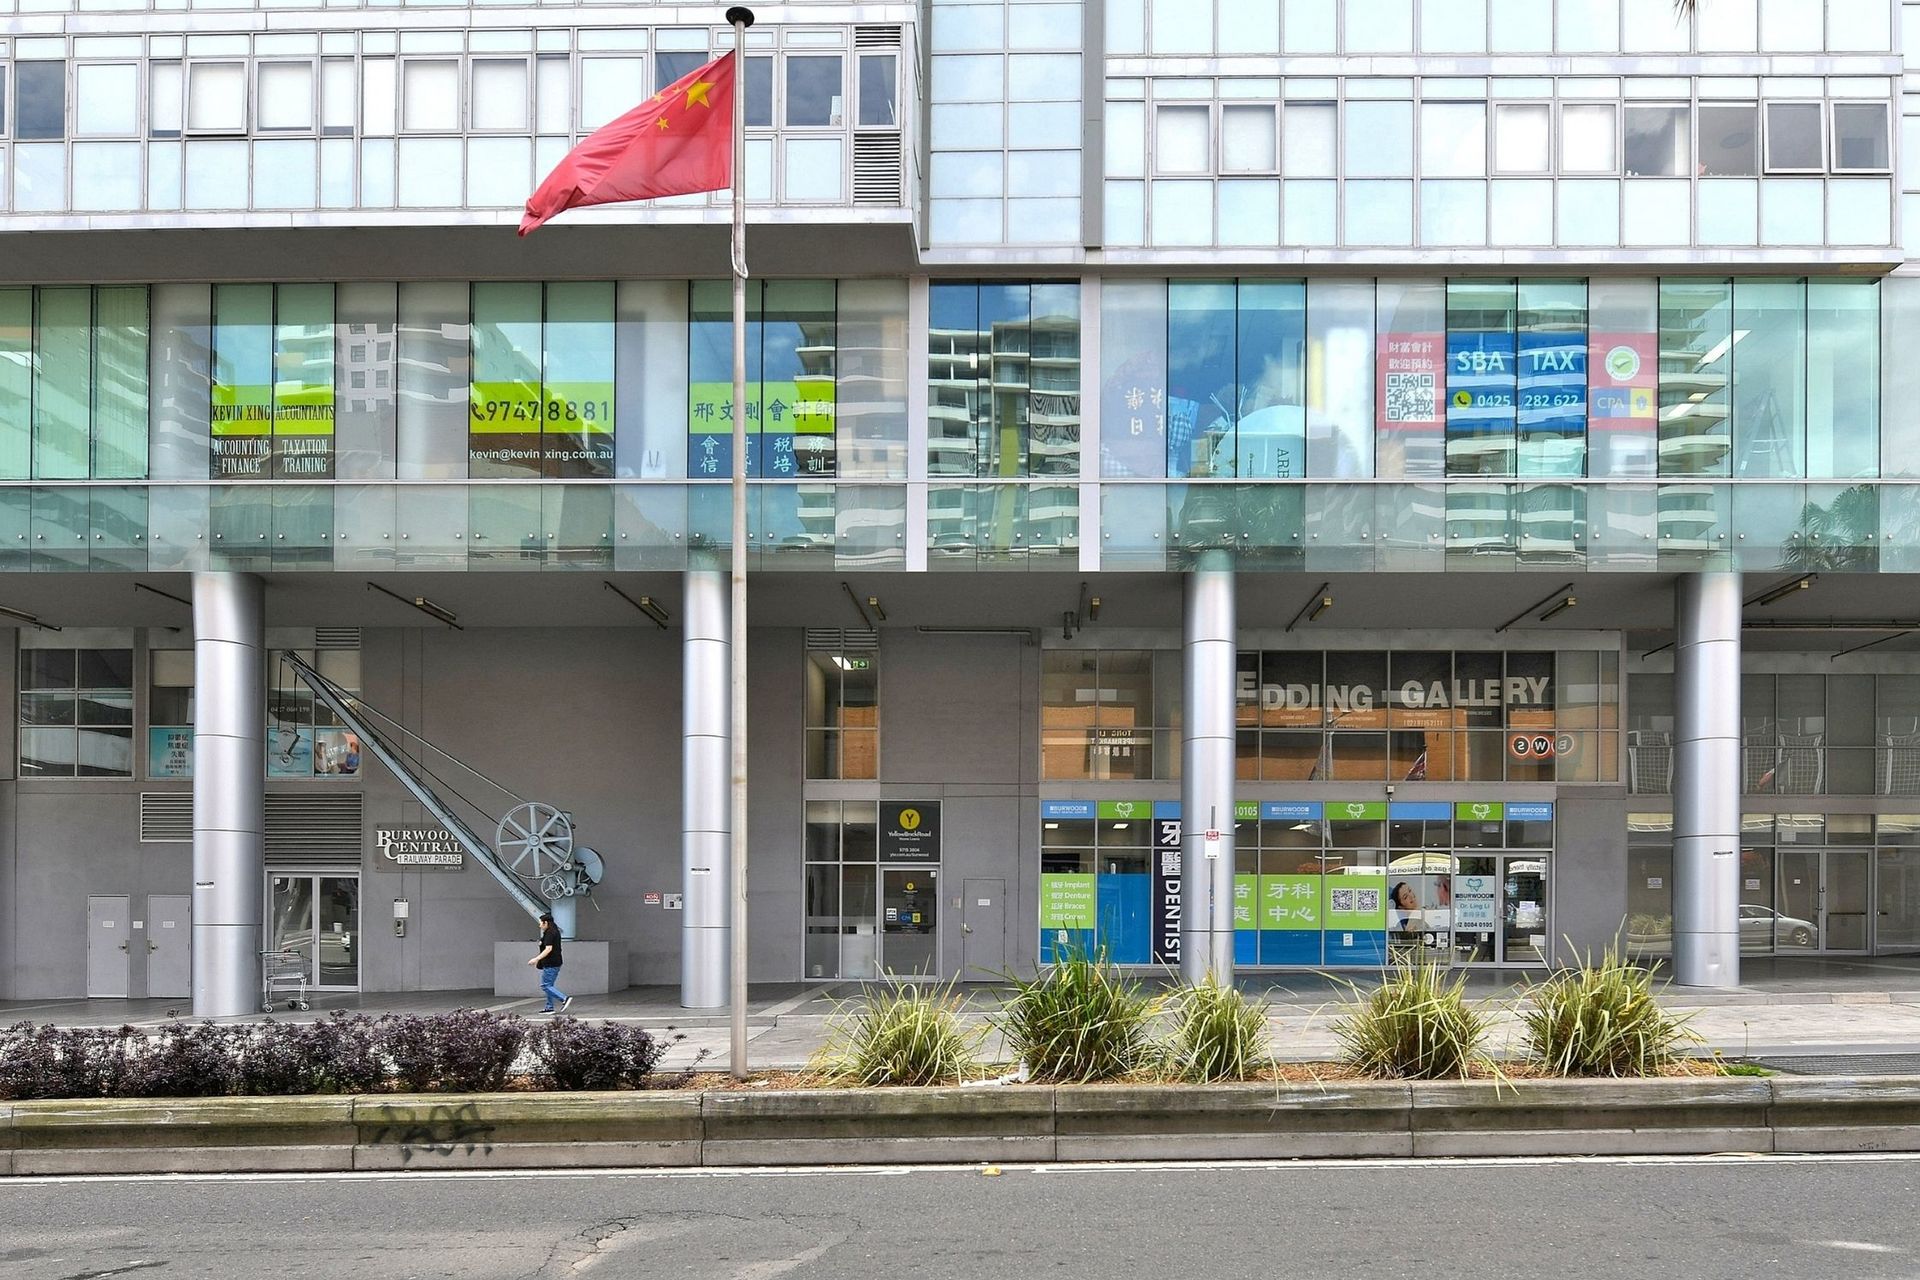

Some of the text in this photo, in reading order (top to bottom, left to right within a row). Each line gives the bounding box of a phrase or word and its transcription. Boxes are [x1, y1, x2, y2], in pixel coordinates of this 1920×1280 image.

[1457, 350, 1575, 371] SBA TAX
[1477, 395, 1579, 407] 0425 282 622
[1597, 397, 1625, 409] CPA
[213, 404, 334, 420] KEVIN XING ACCOUNTANTS
[214, 440, 328, 455] ACCOUNTING TAXATION
[222, 458, 327, 473] FINANCE TRAINING
[1236, 671, 1550, 712] EDDING GALLERY
[1239, 806, 1257, 816] 0105
[376, 830, 456, 847] BURWOO
[384, 841, 462, 860] CENTRAL
[1065, 881, 1090, 889] Implant
[1267, 883, 1315, 899] 牙科
[1165, 880, 1181, 961] DENTIST
[1267, 905, 1316, 921] 中心
